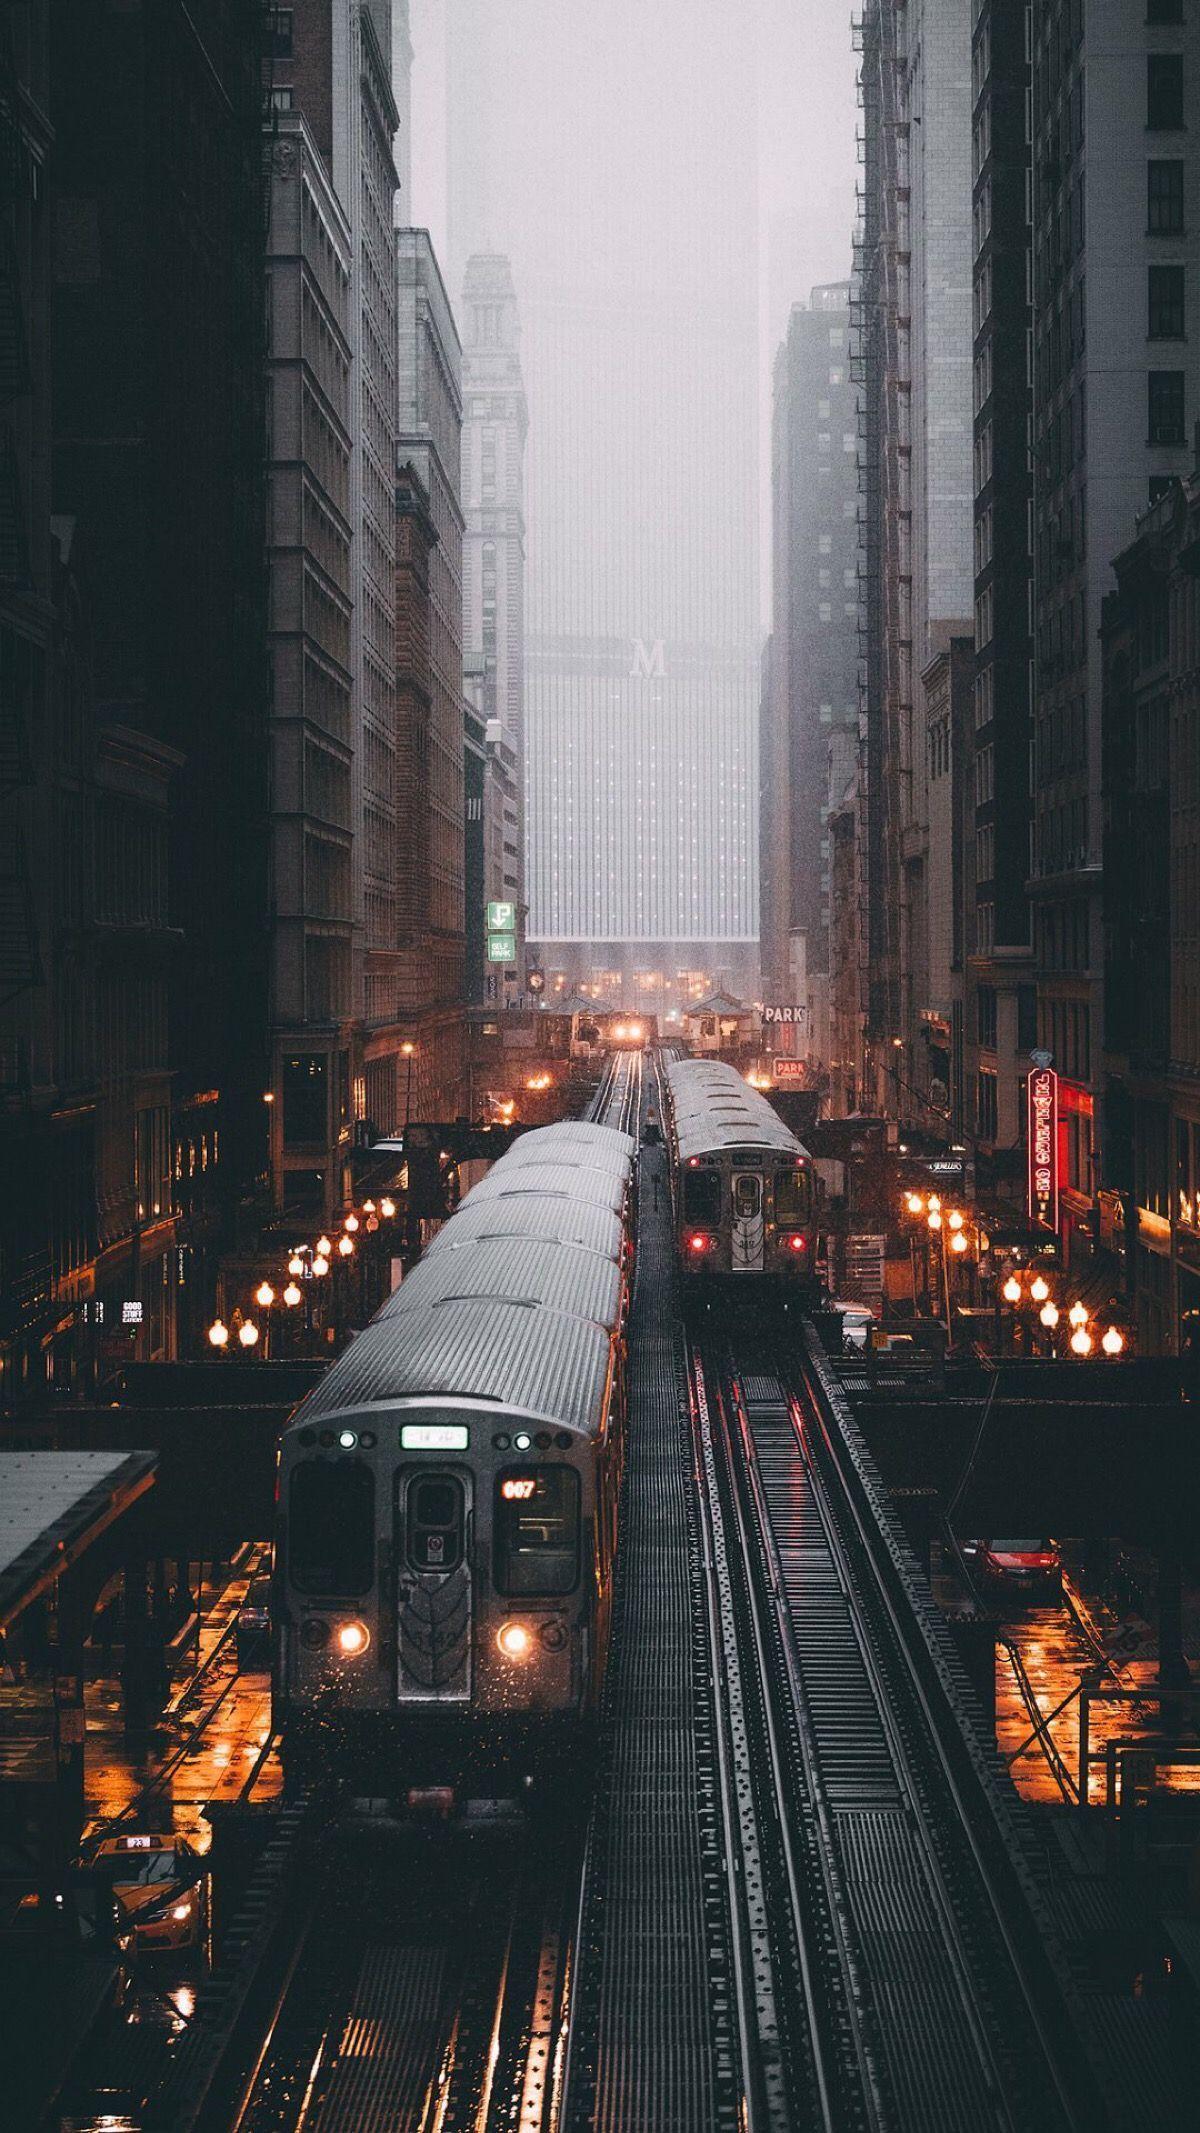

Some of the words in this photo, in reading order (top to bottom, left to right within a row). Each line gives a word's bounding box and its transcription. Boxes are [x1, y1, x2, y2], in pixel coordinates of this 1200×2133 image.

[765, 1007, 802, 1022] PARK
[777, 1062, 805, 1073] PARK
[123, 1302, 142, 1310] GOOD
[122, 1310, 142, 1318] STUFF
